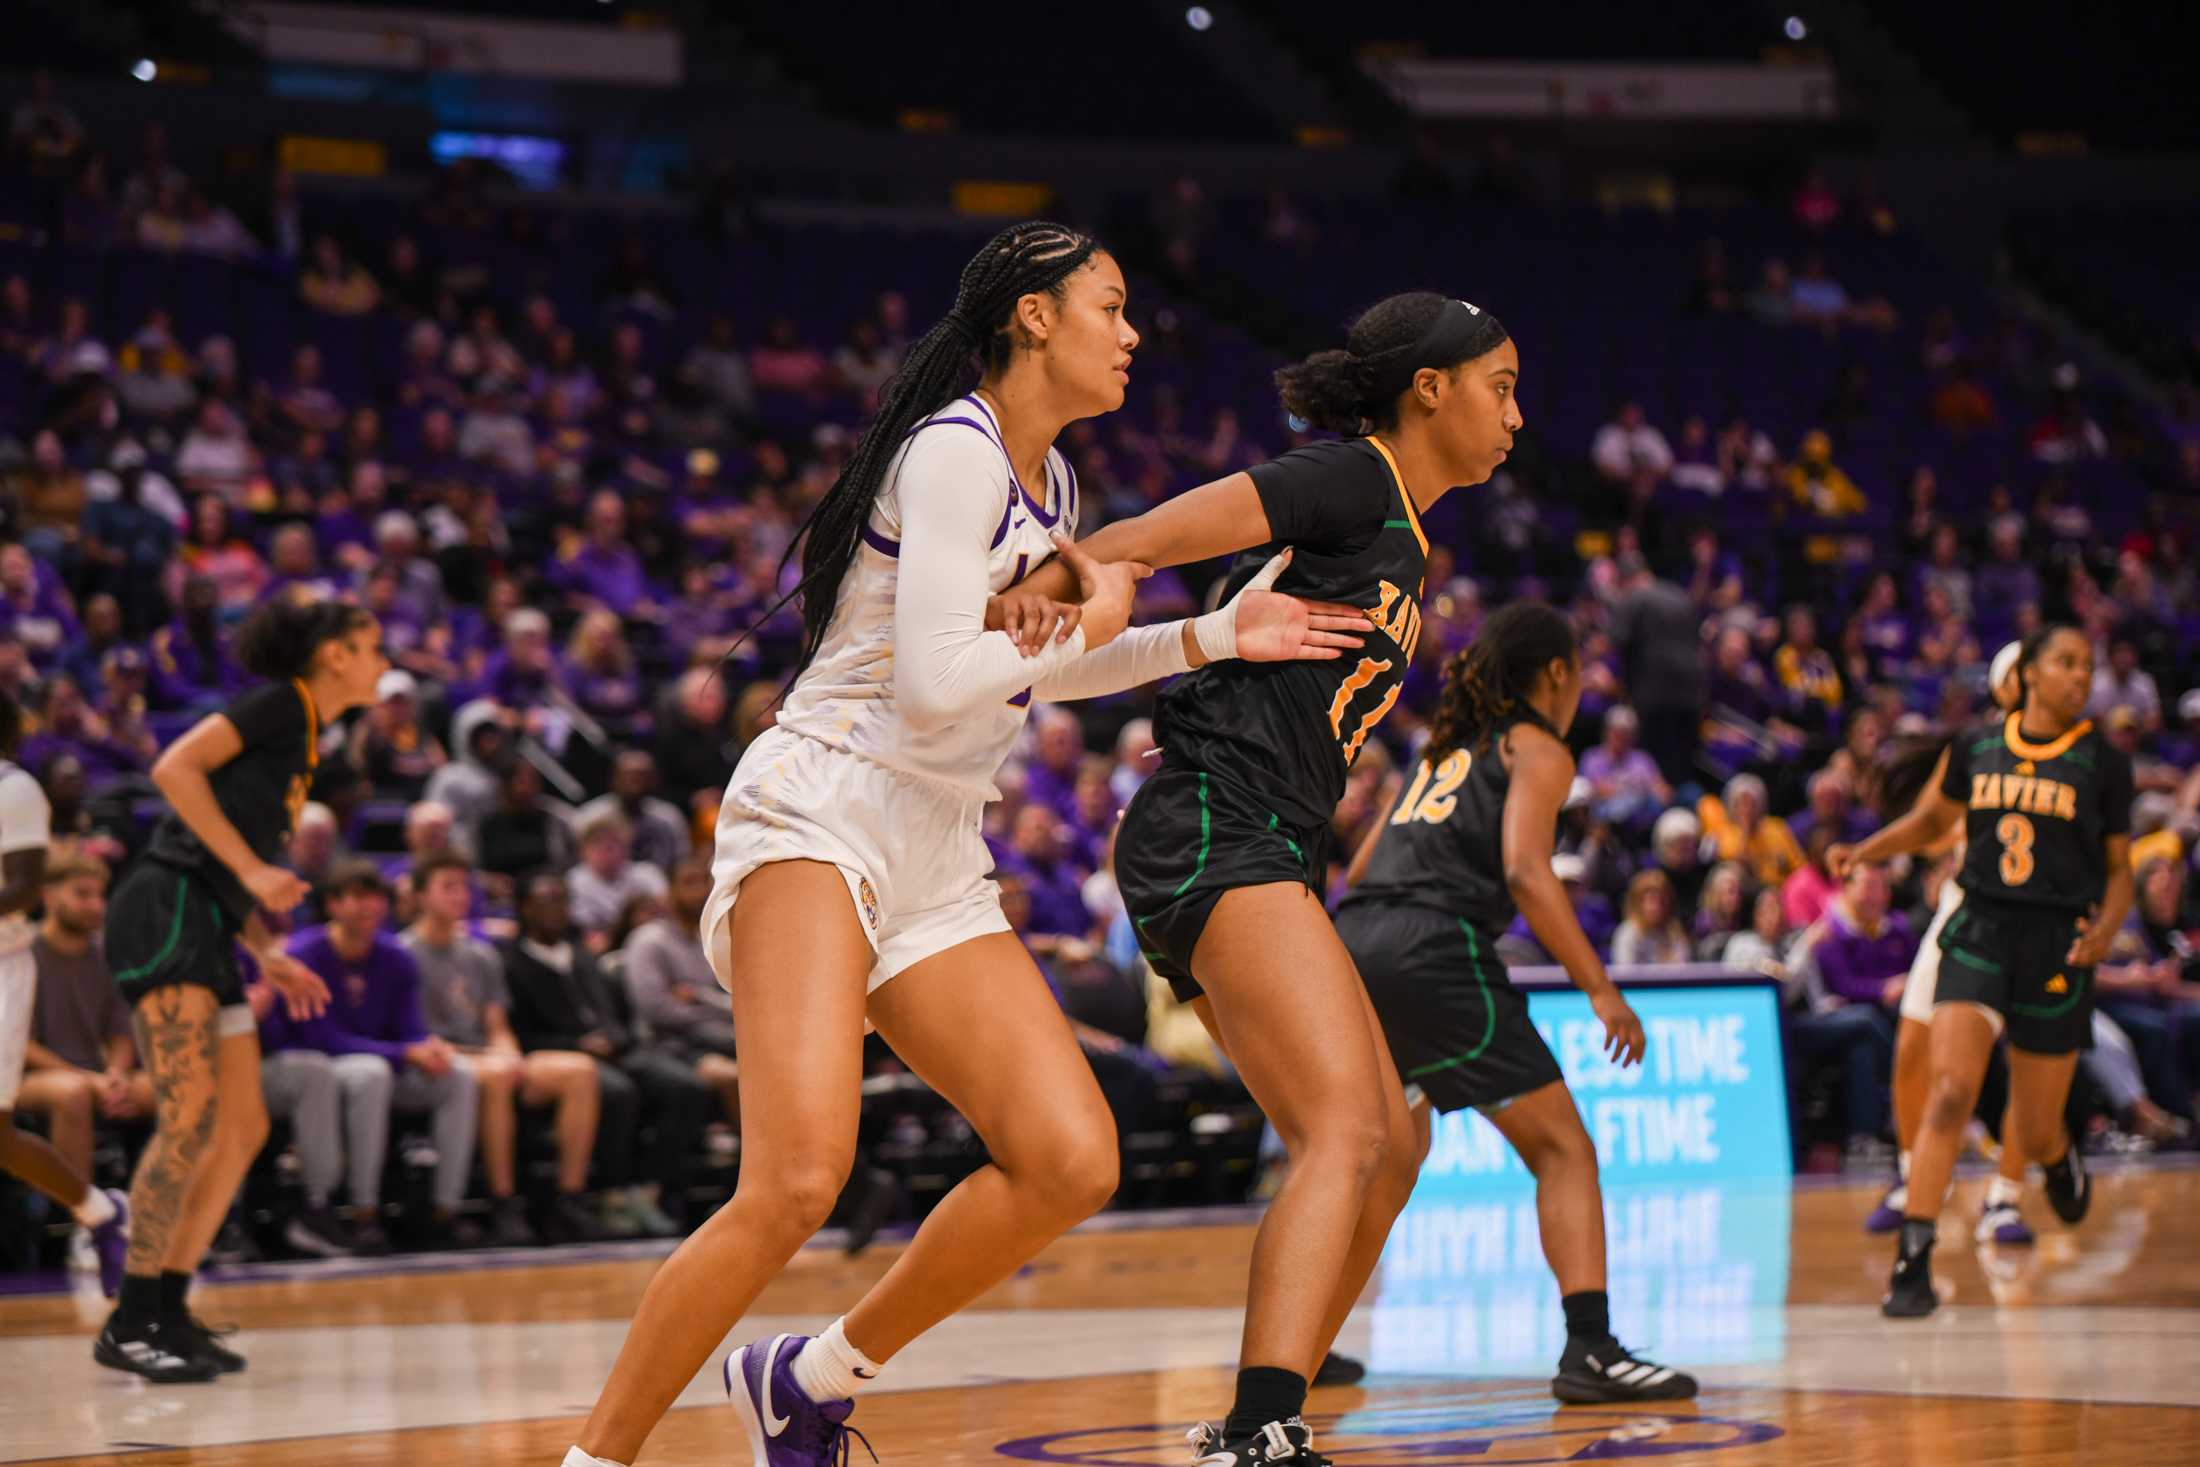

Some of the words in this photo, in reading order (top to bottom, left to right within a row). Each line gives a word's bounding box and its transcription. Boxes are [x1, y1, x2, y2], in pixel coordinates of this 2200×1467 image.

[1390, 747, 1472, 825] 12
[1968, 772, 2078, 822] XAVIER
[1996, 812, 2035, 887] 3
[1650, 1013, 1750, 1085] TIME
[1592, 1093, 1722, 1168] FTIME
